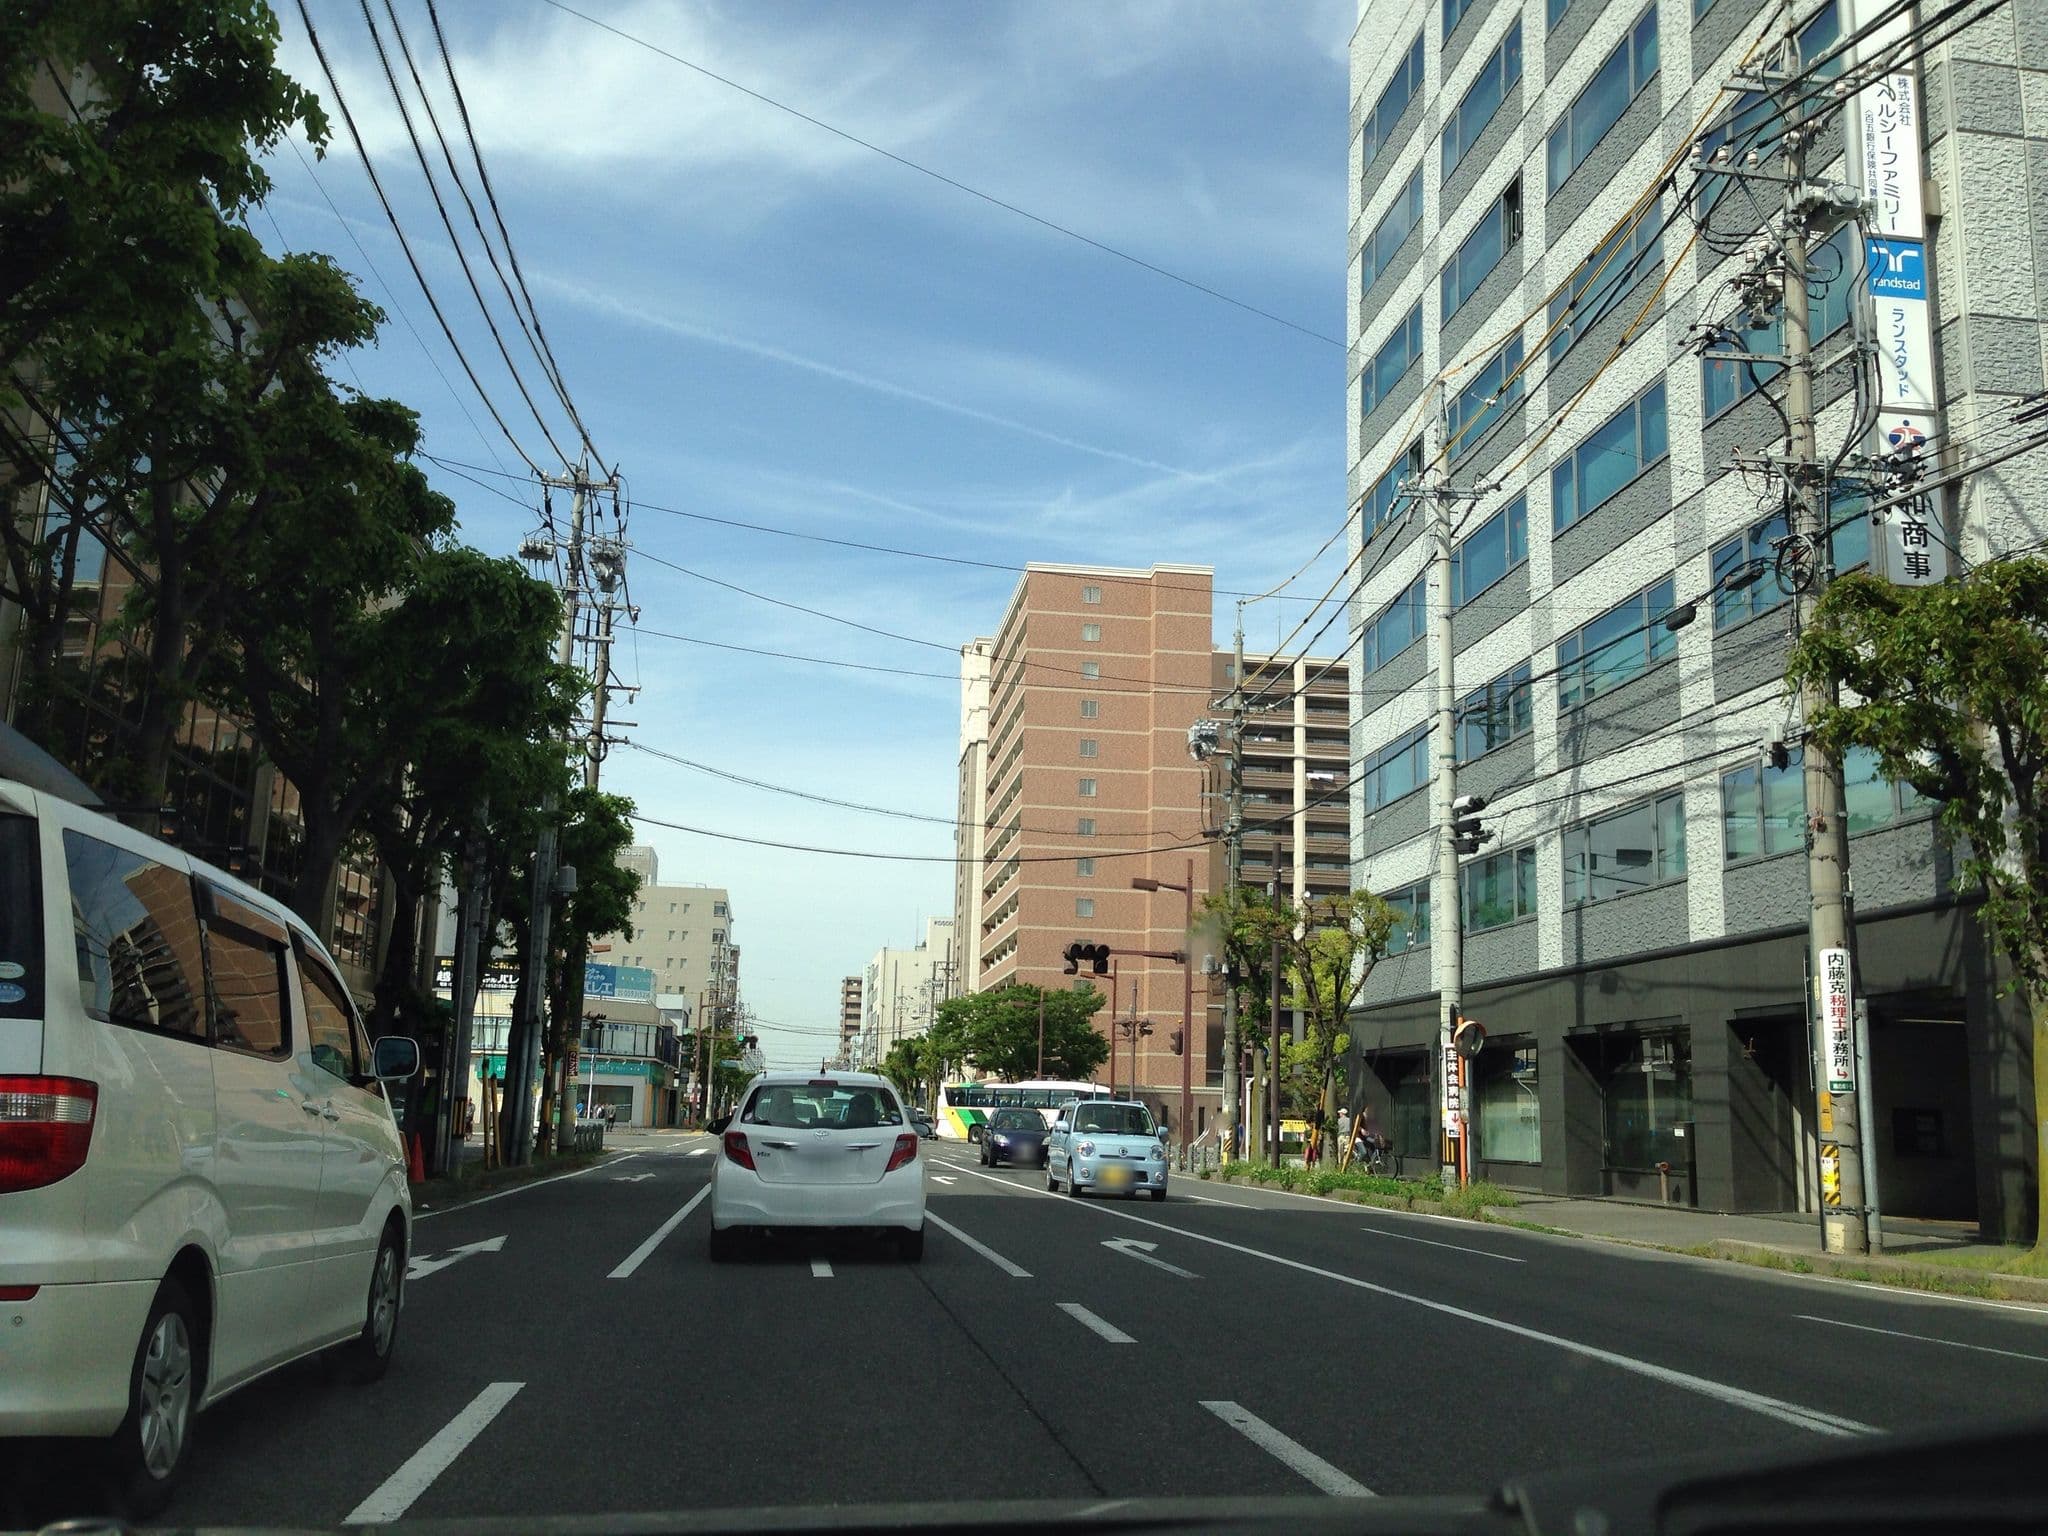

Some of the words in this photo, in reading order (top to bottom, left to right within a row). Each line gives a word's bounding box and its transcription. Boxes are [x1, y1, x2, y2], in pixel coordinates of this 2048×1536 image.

[1897, 77, 1911, 126] 株式会社
[1876, 88, 1901, 231] ヘルシーファミリー
[1872, 277, 1921, 290] randstad
[1891, 308, 1910, 397] ランスタッド
[1827, 952, 1849, 1068] 内藤克税理士事務所
[1446, 1048, 1460, 1110] 主体会病院
